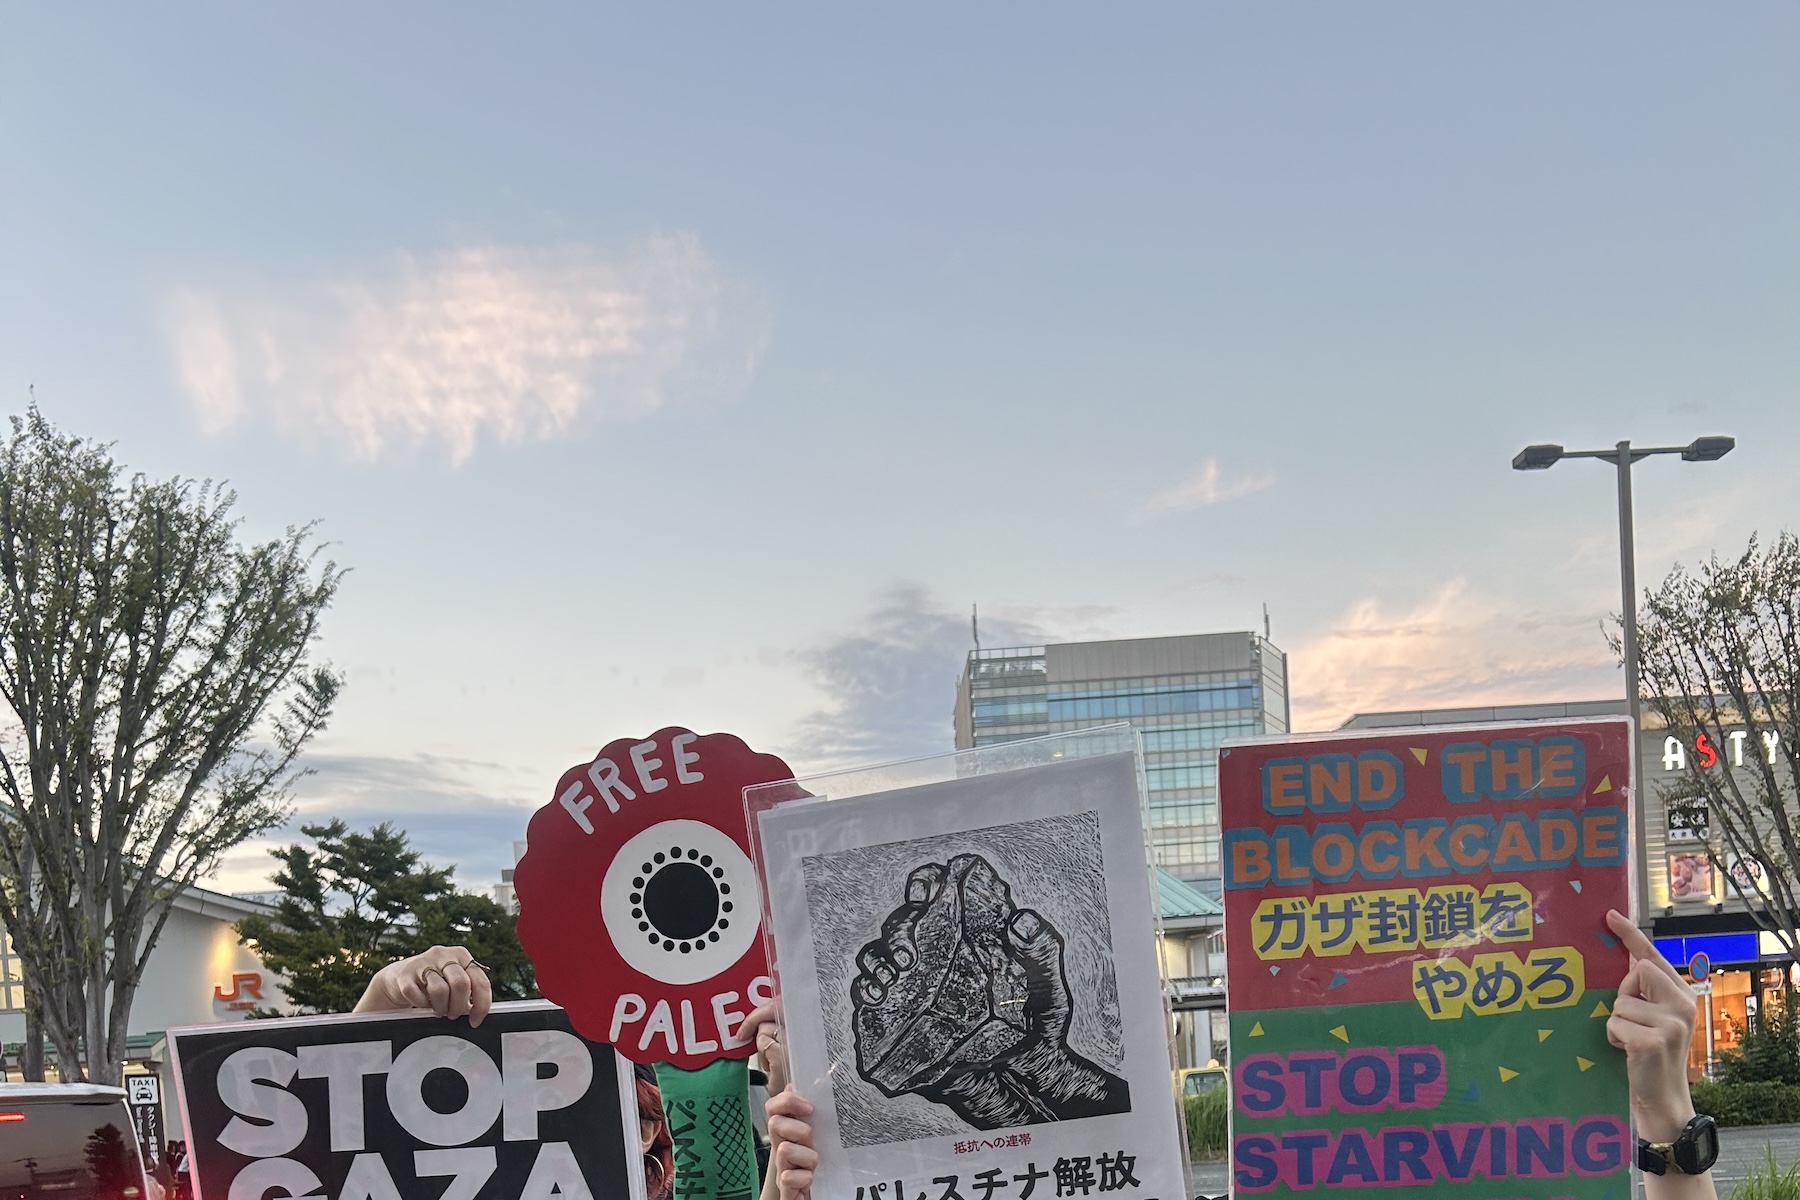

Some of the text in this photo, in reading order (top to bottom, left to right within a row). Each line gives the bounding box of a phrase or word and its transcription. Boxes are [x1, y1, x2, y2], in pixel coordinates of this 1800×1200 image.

[1269, 744, 1577, 807] END THE
[1662, 729, 1779, 771] ASTY
[559, 730, 705, 836] FREE
[1231, 814, 1620, 884] BLOCKCADE
[1259, 887, 1532, 954] ガザ封鎖を
[215, 972, 264, 1001] JR
[1414, 957, 1576, 1014] やめろ
[216, 1029, 594, 1158] STOP
[1241, 1050, 1443, 1112] STOP
[953, 1132, 1032, 1155] 抵抗への連帯
[1234, 1120, 1622, 1188] STARVING
